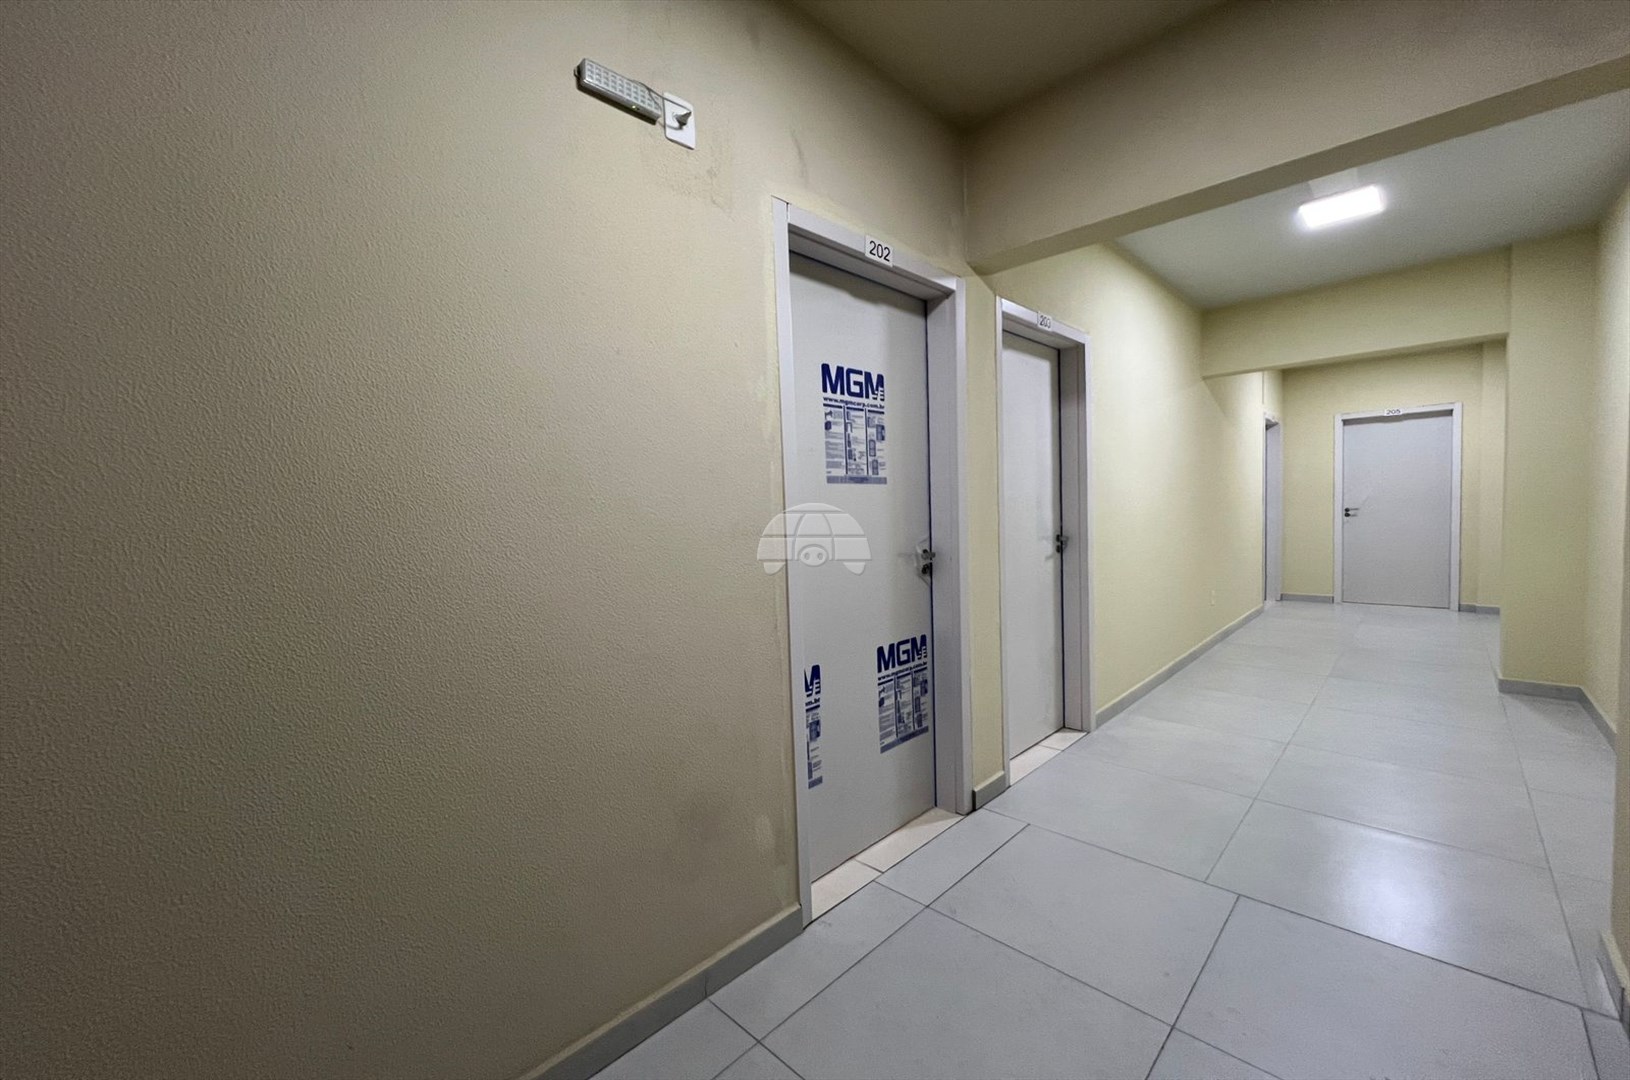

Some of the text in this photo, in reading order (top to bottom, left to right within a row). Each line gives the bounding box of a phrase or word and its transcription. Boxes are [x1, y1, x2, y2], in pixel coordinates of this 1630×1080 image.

[869, 240, 891, 262] 202
[821, 363, 885, 402] MGM
[877, 634, 928, 674] MGM
